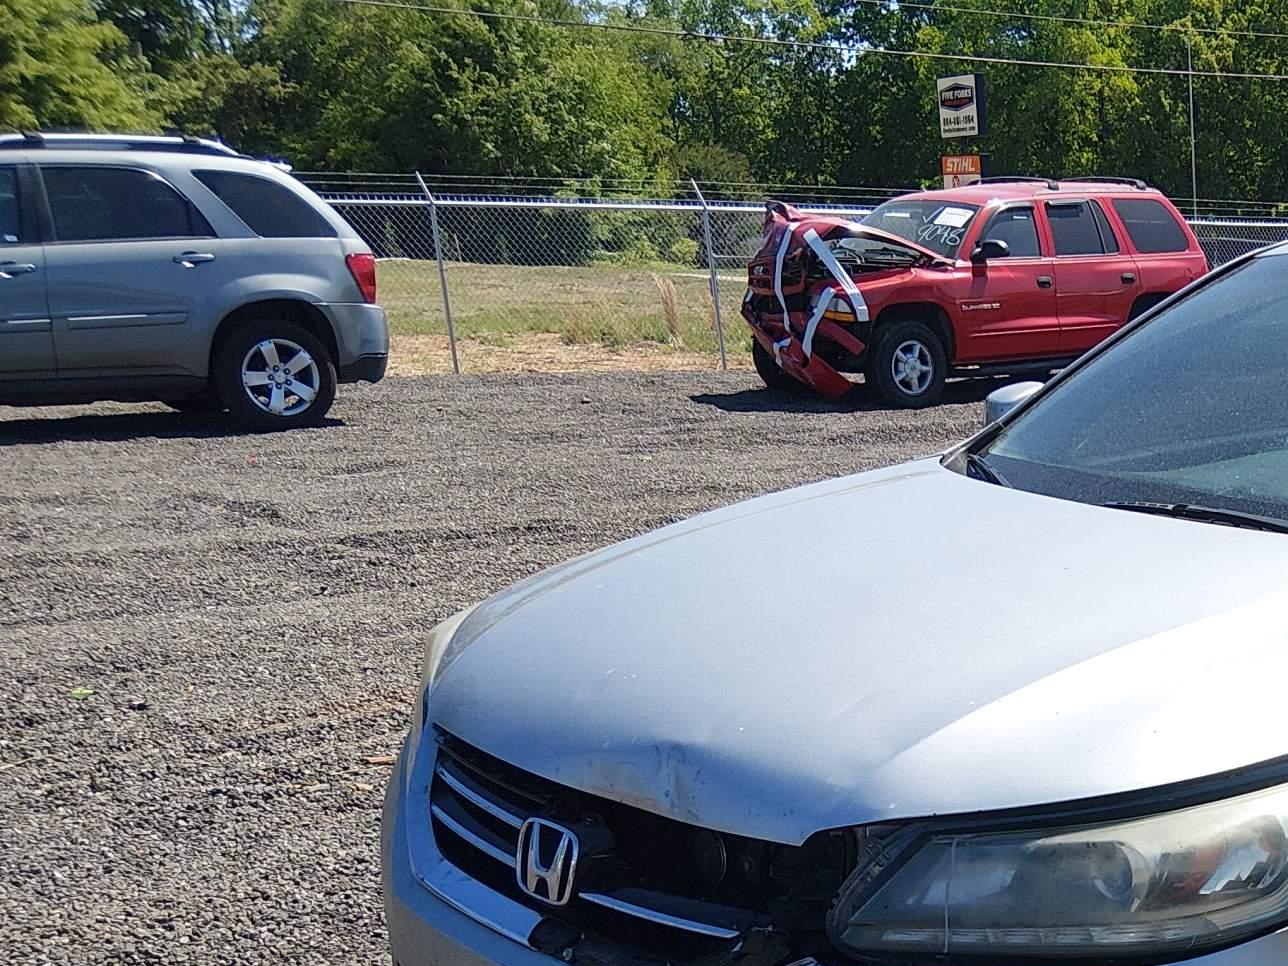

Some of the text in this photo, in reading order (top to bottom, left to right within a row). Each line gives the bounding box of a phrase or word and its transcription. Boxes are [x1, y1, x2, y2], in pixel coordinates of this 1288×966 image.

[941, 91, 954, 101] FIVE
[946, 157, 976, 172] STIHL
[918, 224, 966, 247] 9048
